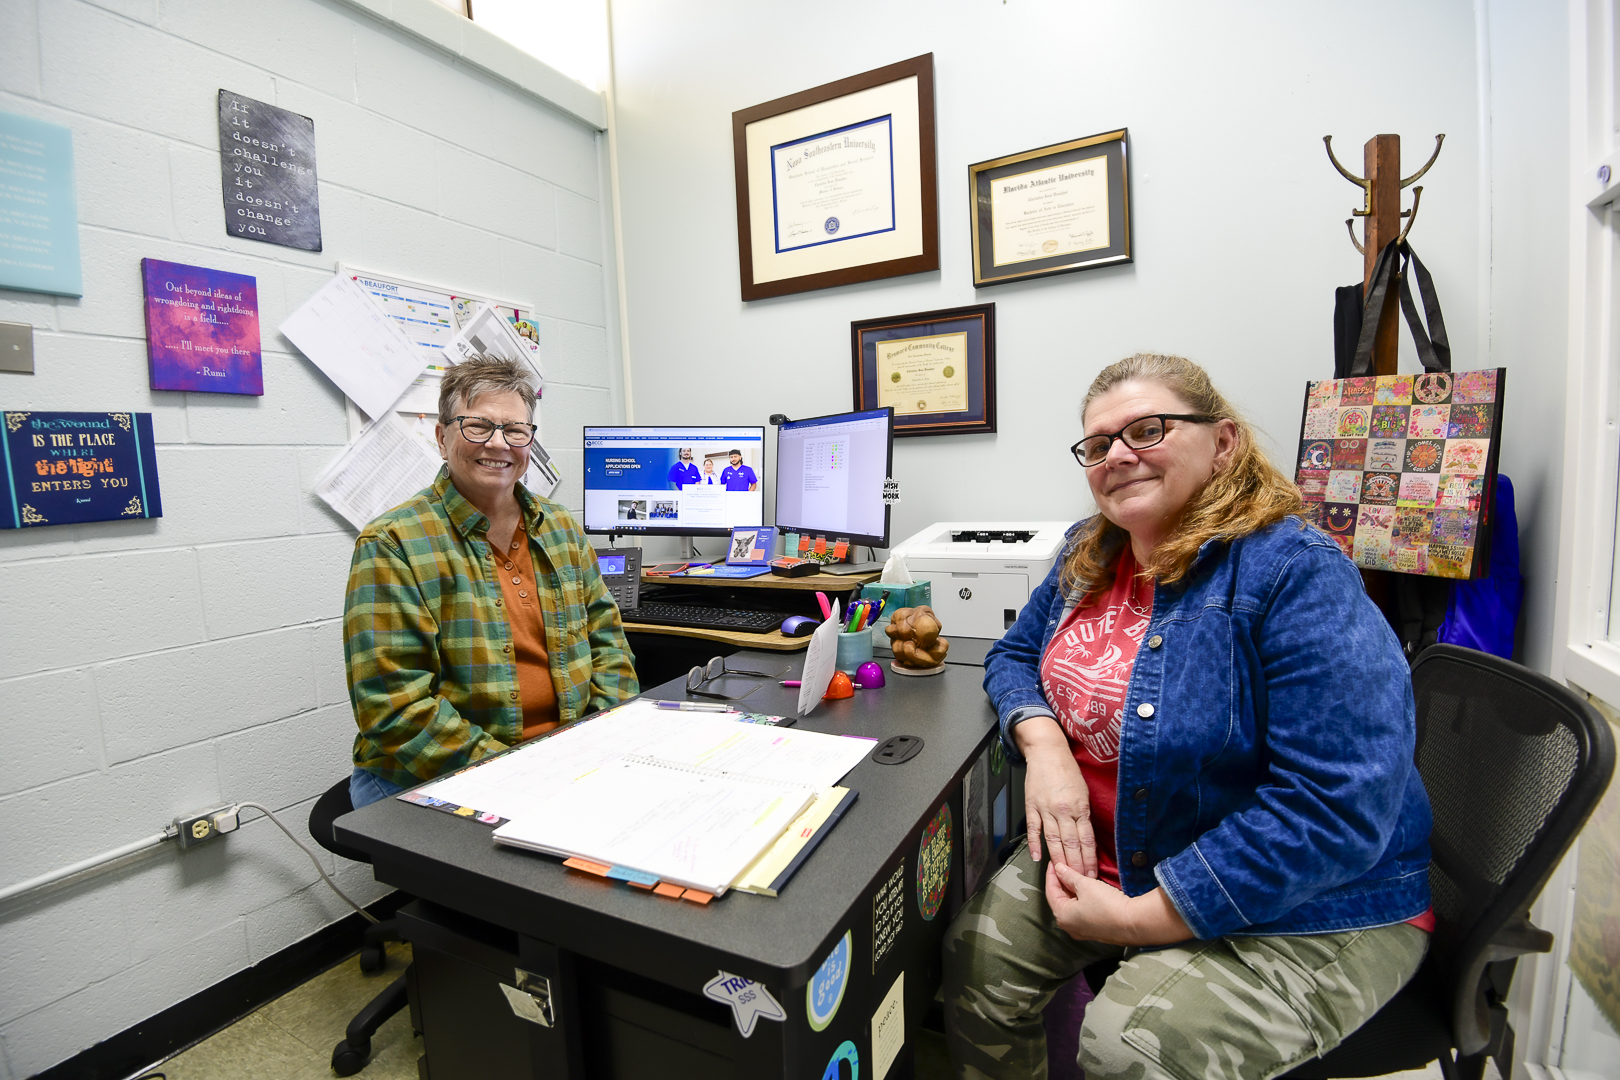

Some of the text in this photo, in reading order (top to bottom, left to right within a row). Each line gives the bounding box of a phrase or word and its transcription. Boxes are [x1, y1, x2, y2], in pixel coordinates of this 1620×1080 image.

[232, 100, 249, 114] If
[232, 116, 249, 128] it
[804, 142, 842, 160] Southeastern
[844, 136, 876, 153] University
[234, 148, 313, 175] challenge
[234, 163, 262, 177] you
[235, 176, 252, 188] it
[1003, 184, 1028, 194] Florida
[1030, 177, 1056, 188] Atlantic
[1058, 169, 1094, 182] University
[237, 208, 291, 226] change
[238, 224, 266, 236] you
[165, 281, 242, 302] Out beyond ideas of
[364, 280, 399, 292] BEAUFORT
[154, 296, 254, 317] wrongdoing and rightdoing
[184, 312, 190, 320] is
[180, 340, 192, 351] I'll
[216, 347, 229, 355] you
[231, 345, 250, 356] there
[887, 347, 908, 360] Broward
[908, 343, 935, 351] Community
[936, 342, 955, 352] College
[203, 366, 226, 377] Rumi
[1348, 386, 1371, 396] HAPPY
[30, 418, 110, 430] the wound
[1382, 420, 1397, 428] BIG
[32, 433, 116, 447] IS THE PLACE
[50, 448, 95, 456] WHERE
[35, 458, 114, 477] the light
[31, 478, 128, 492] ENTERS YOU
[1369, 507, 1386, 515] LOVE
[960, 587, 972, 600] hp
[1056, 684, 1081, 705] EST.
[827, 960, 836, 976] is
[818, 960, 843, 1006] good.
[738, 990, 757, 1005] SSS
